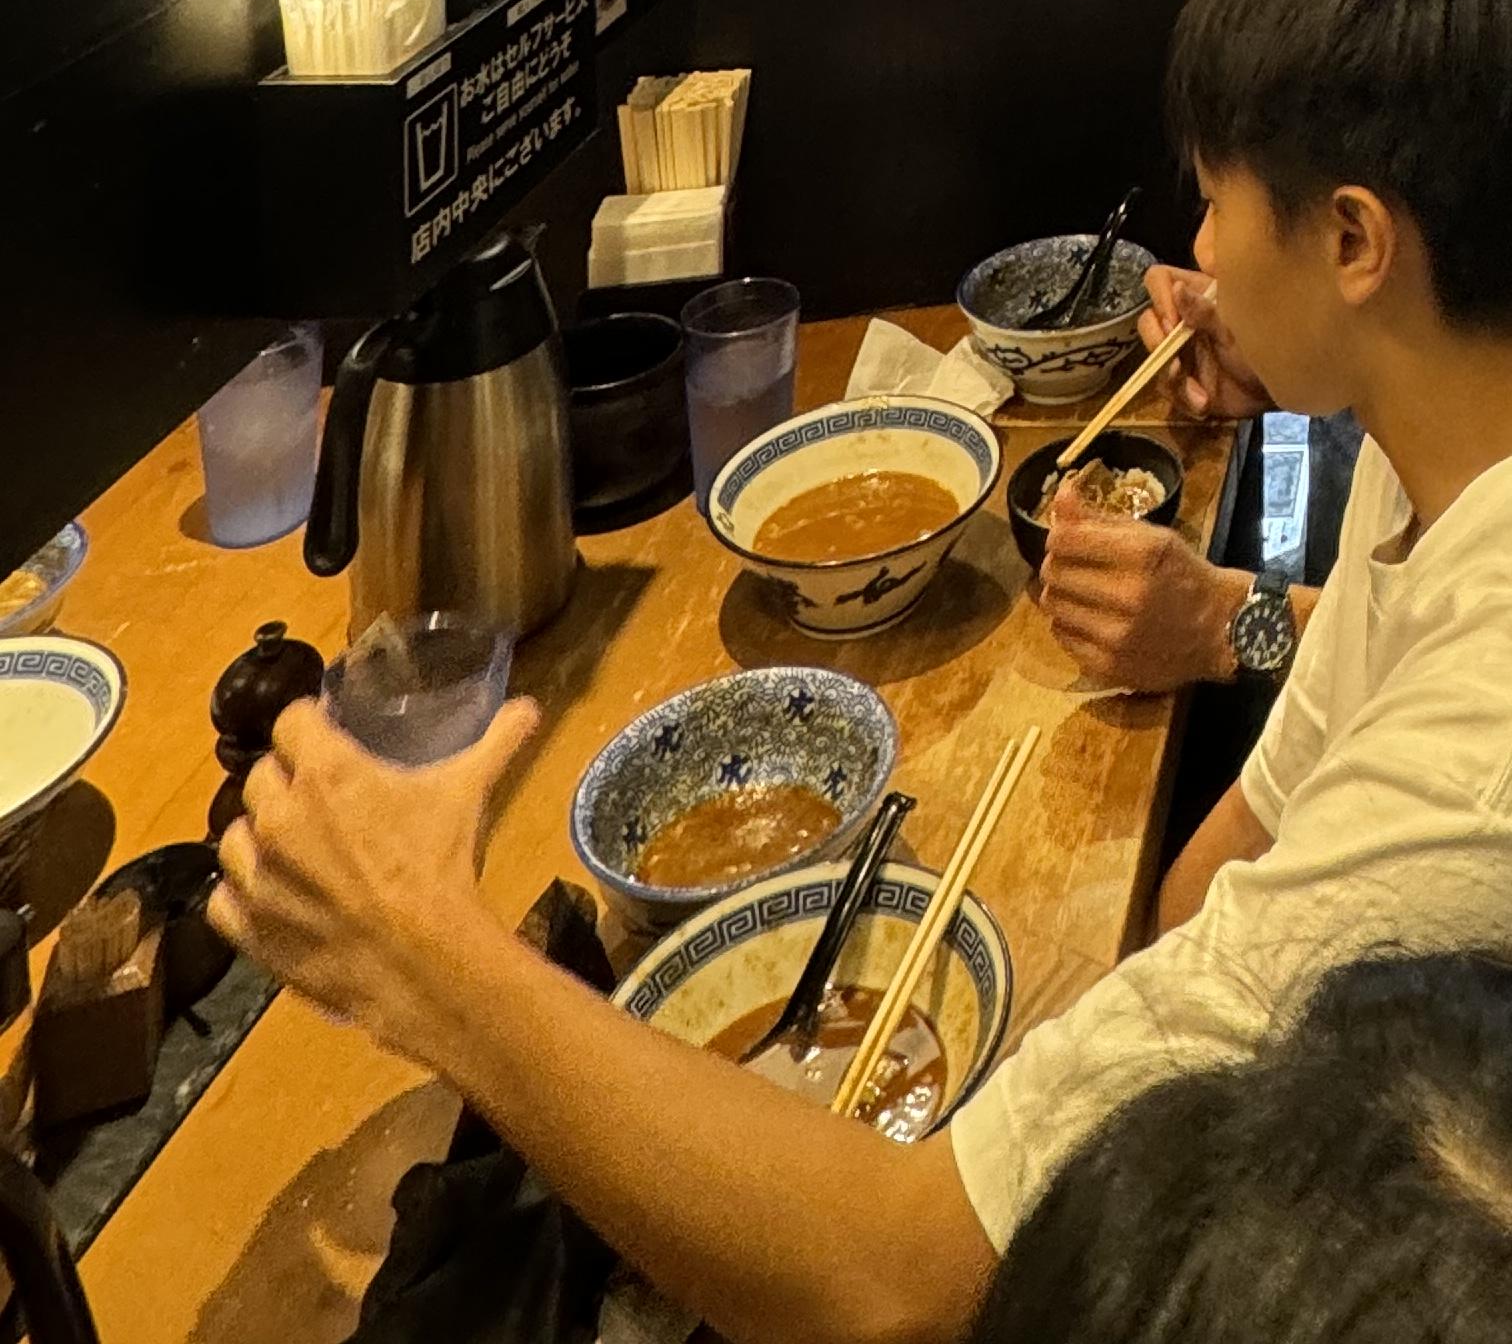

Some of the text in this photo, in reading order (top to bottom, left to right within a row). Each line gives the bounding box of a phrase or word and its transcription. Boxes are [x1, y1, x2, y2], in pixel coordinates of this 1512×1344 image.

[481, 29, 573, 125] ご自由にどうぞ
[411, 93, 582, 264] 店内中央にございます。
